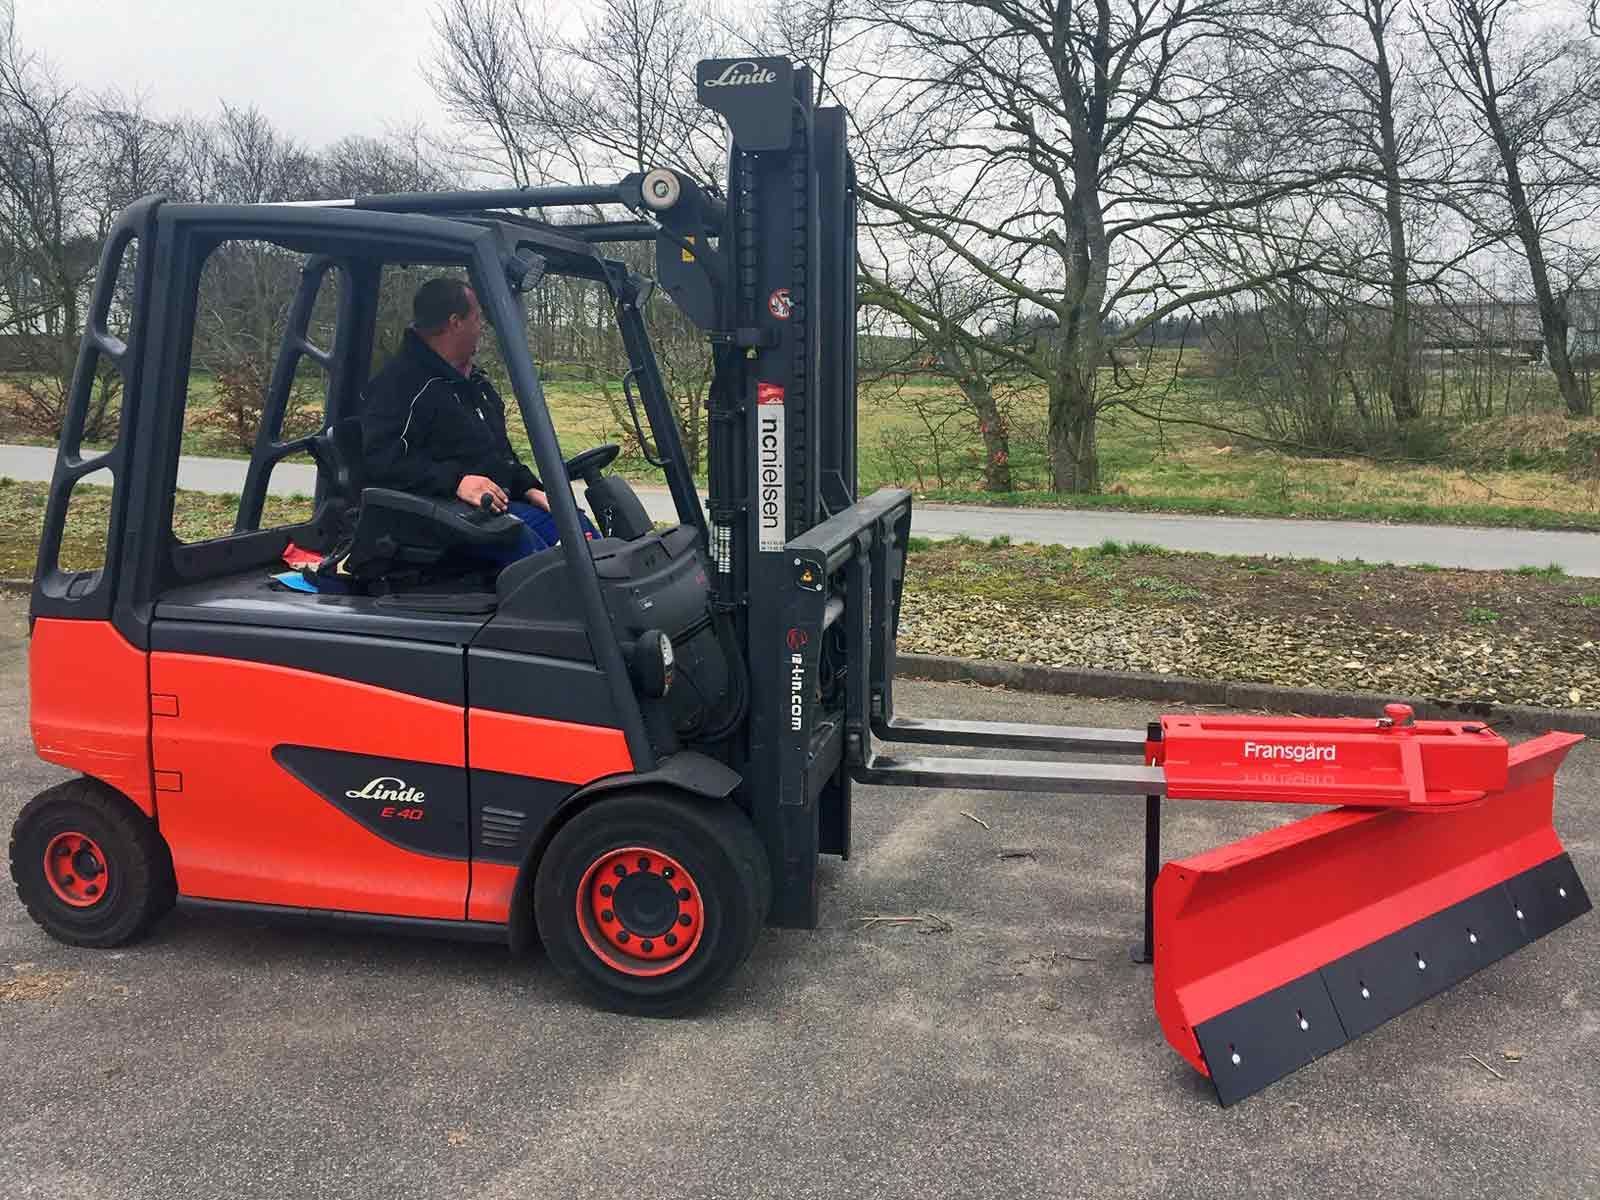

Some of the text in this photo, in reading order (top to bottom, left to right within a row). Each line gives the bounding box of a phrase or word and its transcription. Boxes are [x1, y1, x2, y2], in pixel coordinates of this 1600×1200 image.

[703, 61, 777, 87] Linde
[761, 418, 783, 529] ncnielsen
[1244, 741, 1337, 762] Fransgård
[345, 776, 425, 802] Linde
[381, 807, 424, 821] E 40
